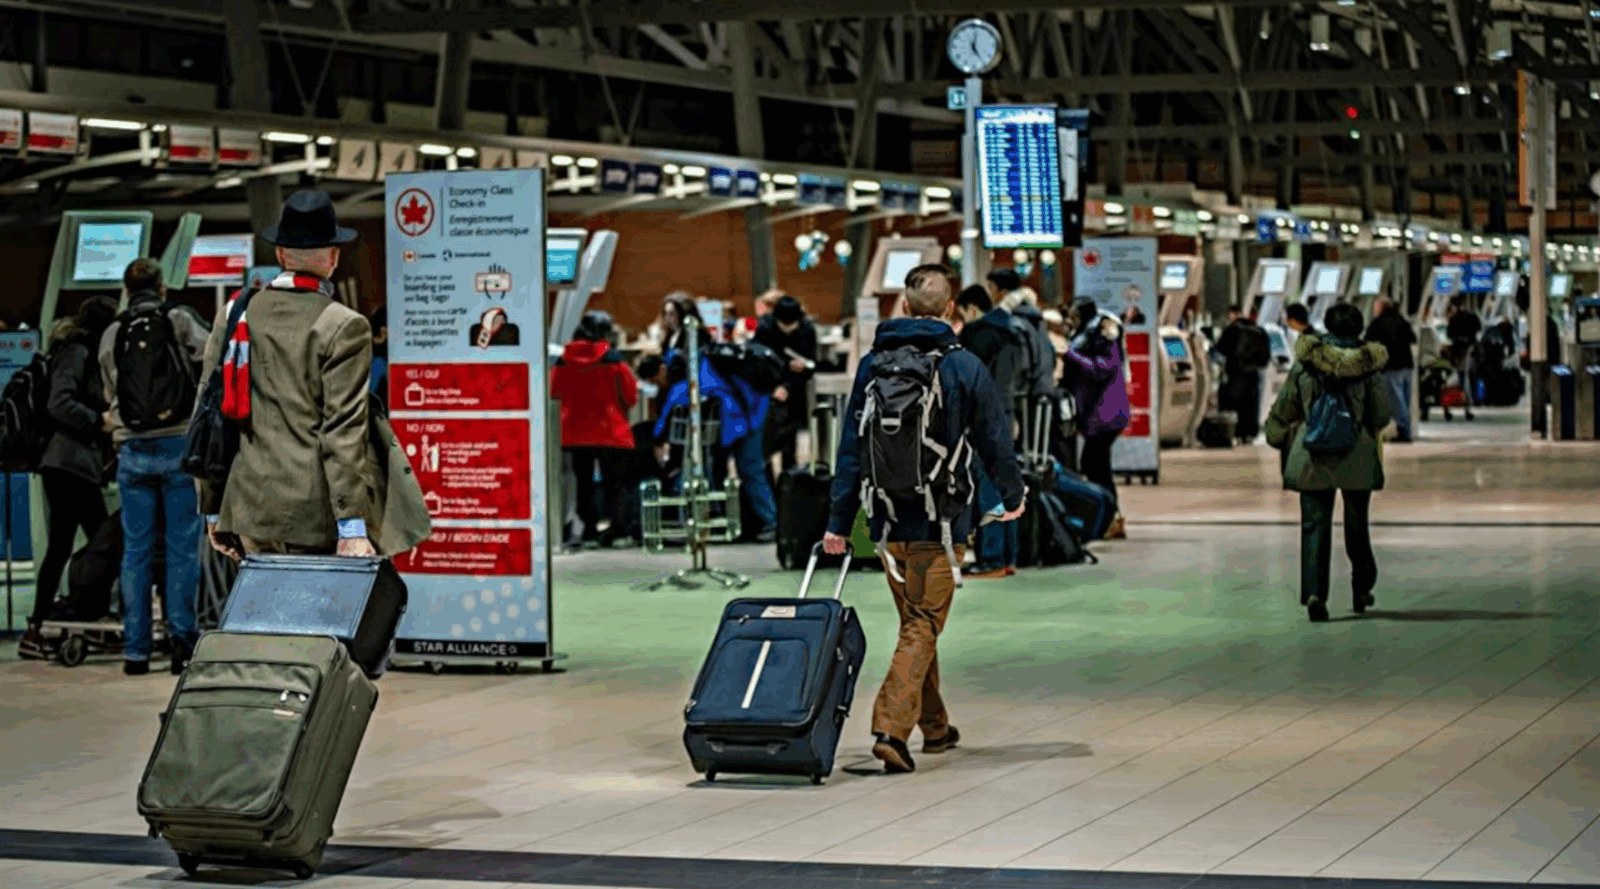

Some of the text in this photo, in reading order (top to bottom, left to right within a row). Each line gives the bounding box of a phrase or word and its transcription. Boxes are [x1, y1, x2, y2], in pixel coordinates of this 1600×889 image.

[449, 186, 514, 198] Economy Class
[449, 199, 486, 209] Check-in
[449, 214, 514, 226] Enregistrement
[450, 226, 529, 238] classe économique
[404, 283, 437, 294] boarding
[415, 293, 429, 304] bag
[406, 369, 418, 379] YES
[406, 423, 419, 433] NO
[425, 423, 445, 433] NON
[413, 641, 507, 655] STAR ALLIANCE
